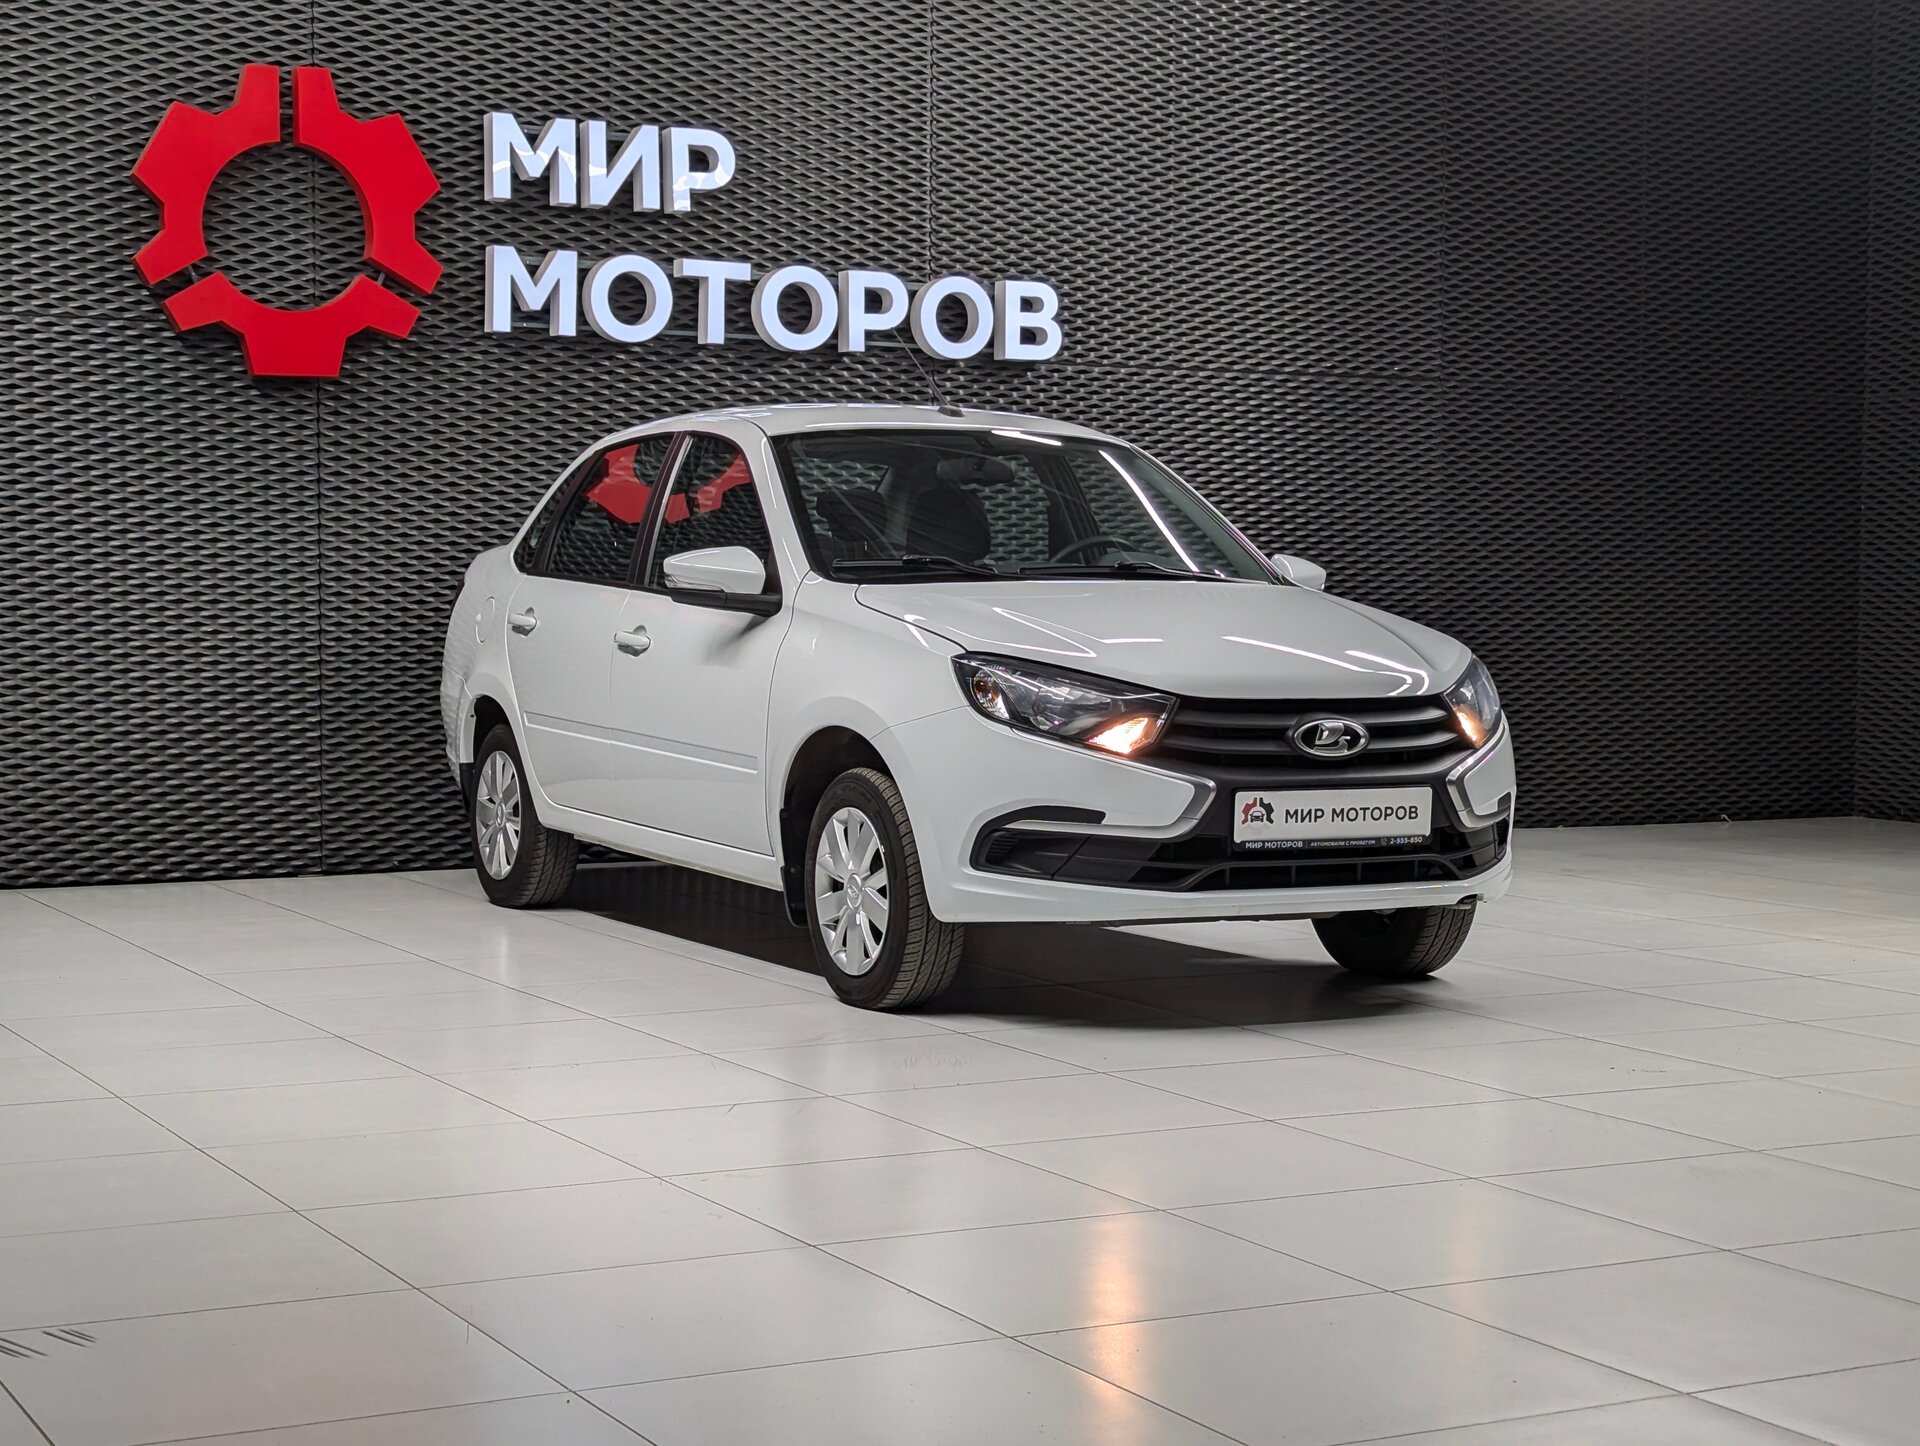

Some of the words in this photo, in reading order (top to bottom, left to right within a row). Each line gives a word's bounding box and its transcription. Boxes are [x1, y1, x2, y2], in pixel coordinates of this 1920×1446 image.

[484, 112, 736, 213] МИР
[485, 245, 1063, 361] МОТОРОВ
[1285, 808, 1325, 824] МИР
[1331, 805, 1419, 823] МОТОРОВ
[1264, 841, 1303, 849] МОТОРОВ
